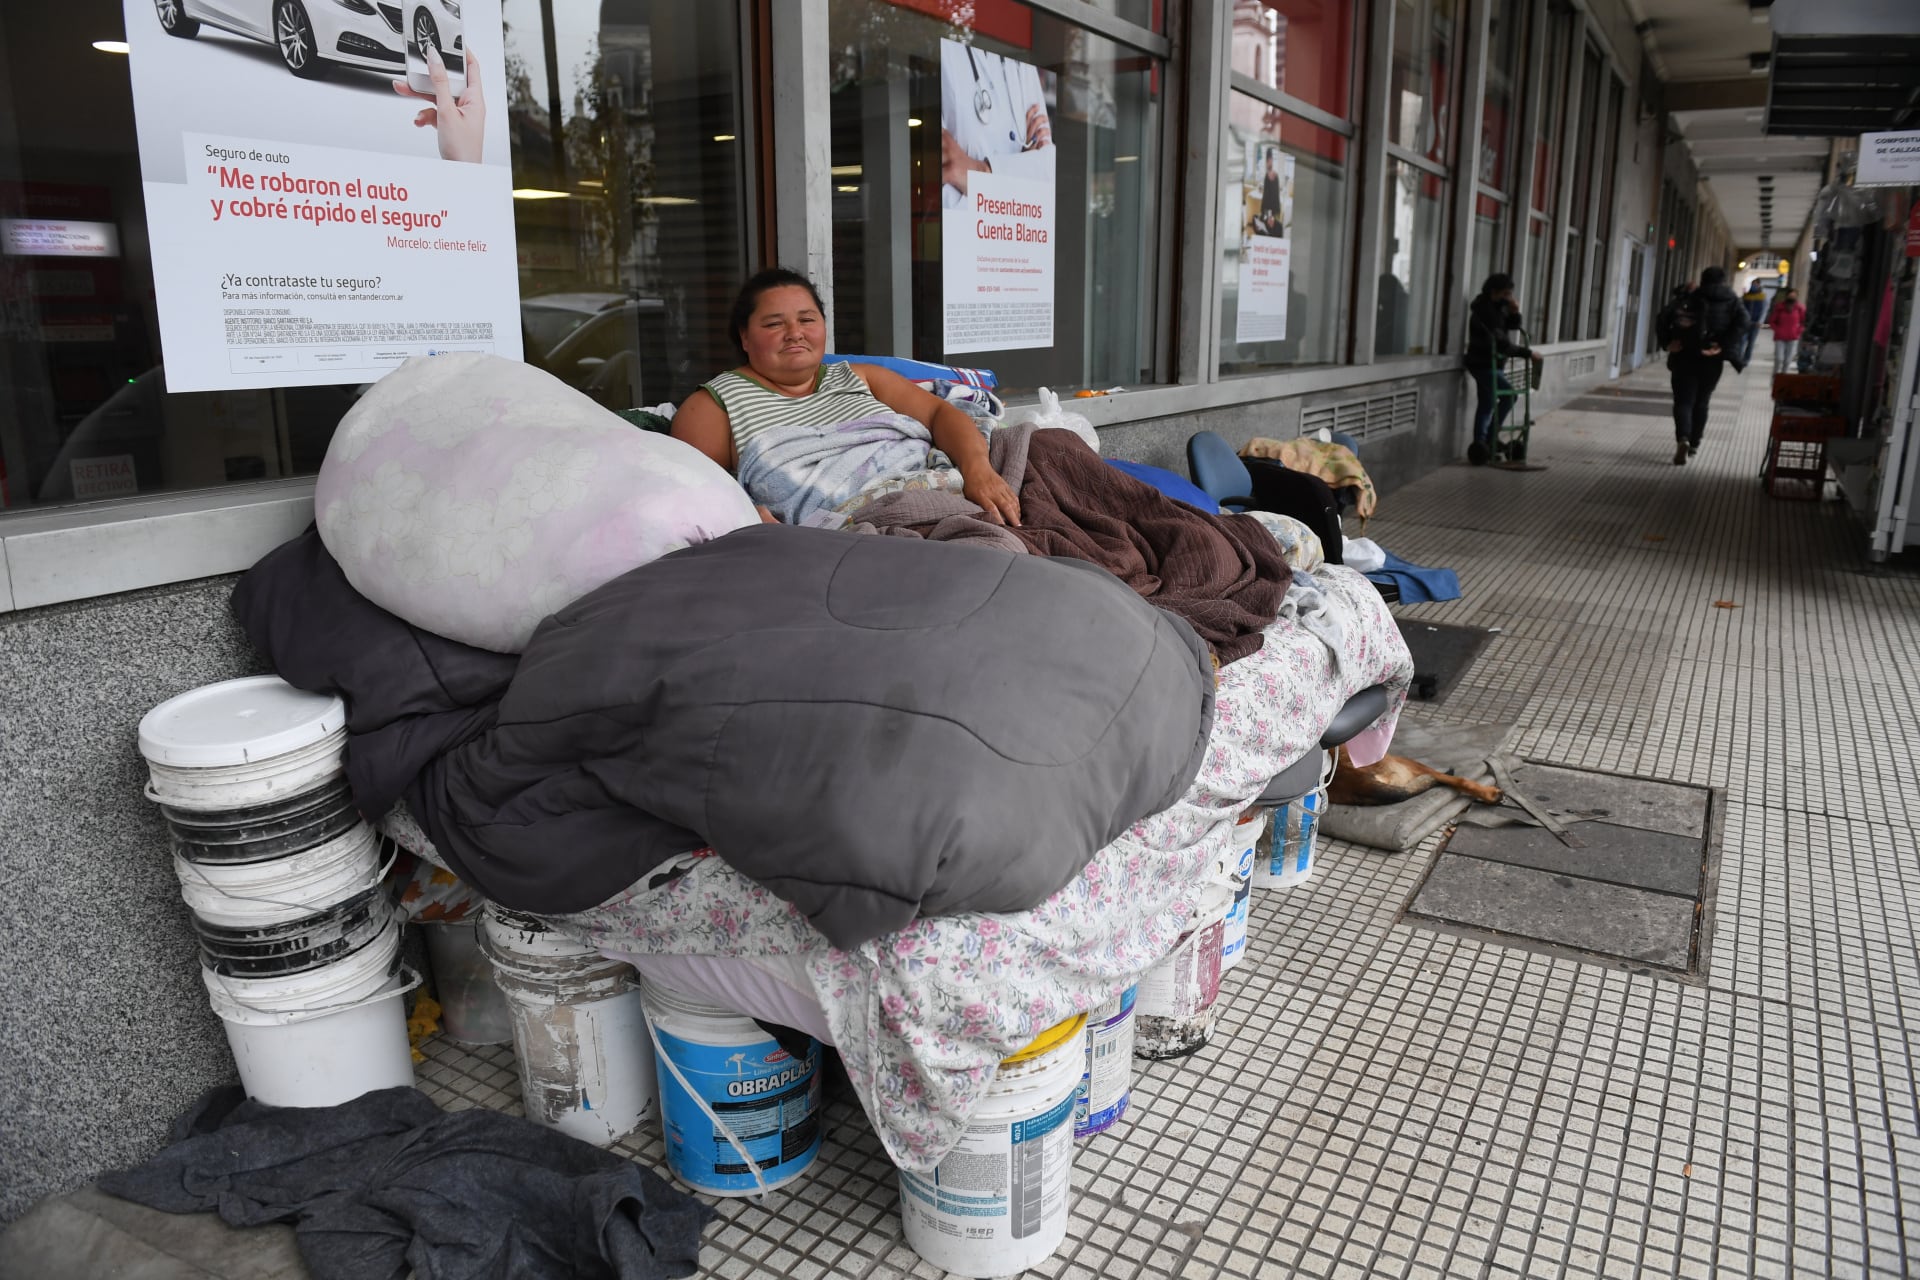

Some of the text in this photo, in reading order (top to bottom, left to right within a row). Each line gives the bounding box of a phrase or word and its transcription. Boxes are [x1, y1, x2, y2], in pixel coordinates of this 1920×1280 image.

[205, 144, 290, 164] Seguro de auto
[260, 172, 341, 196] robaron
[345, 178, 361, 198] el
[367, 182, 408, 201] auto
[210, 199, 224, 221] y
[229, 196, 288, 219] cobré
[293, 199, 356, 226] rápido
[360, 204, 377, 224] el
[976, 192, 1042, 219] Presentamos
[976, 219, 1048, 243] Cuenta Blanca
[387, 235, 487, 252] Marcelo: cliente feliz
[220, 273, 381, 291] ¿Ya contrataste tu seguro?
[222, 291, 240, 300] Para
[241, 291, 258, 300] más
[259, 291, 306, 301] información,
[306, 292, 337, 300] consultá
[347, 292, 404, 301] santander.com.ar
[727, 1052, 816, 1097] OBRAPLAST
[1014, 1125, 1022, 1142] 4024
